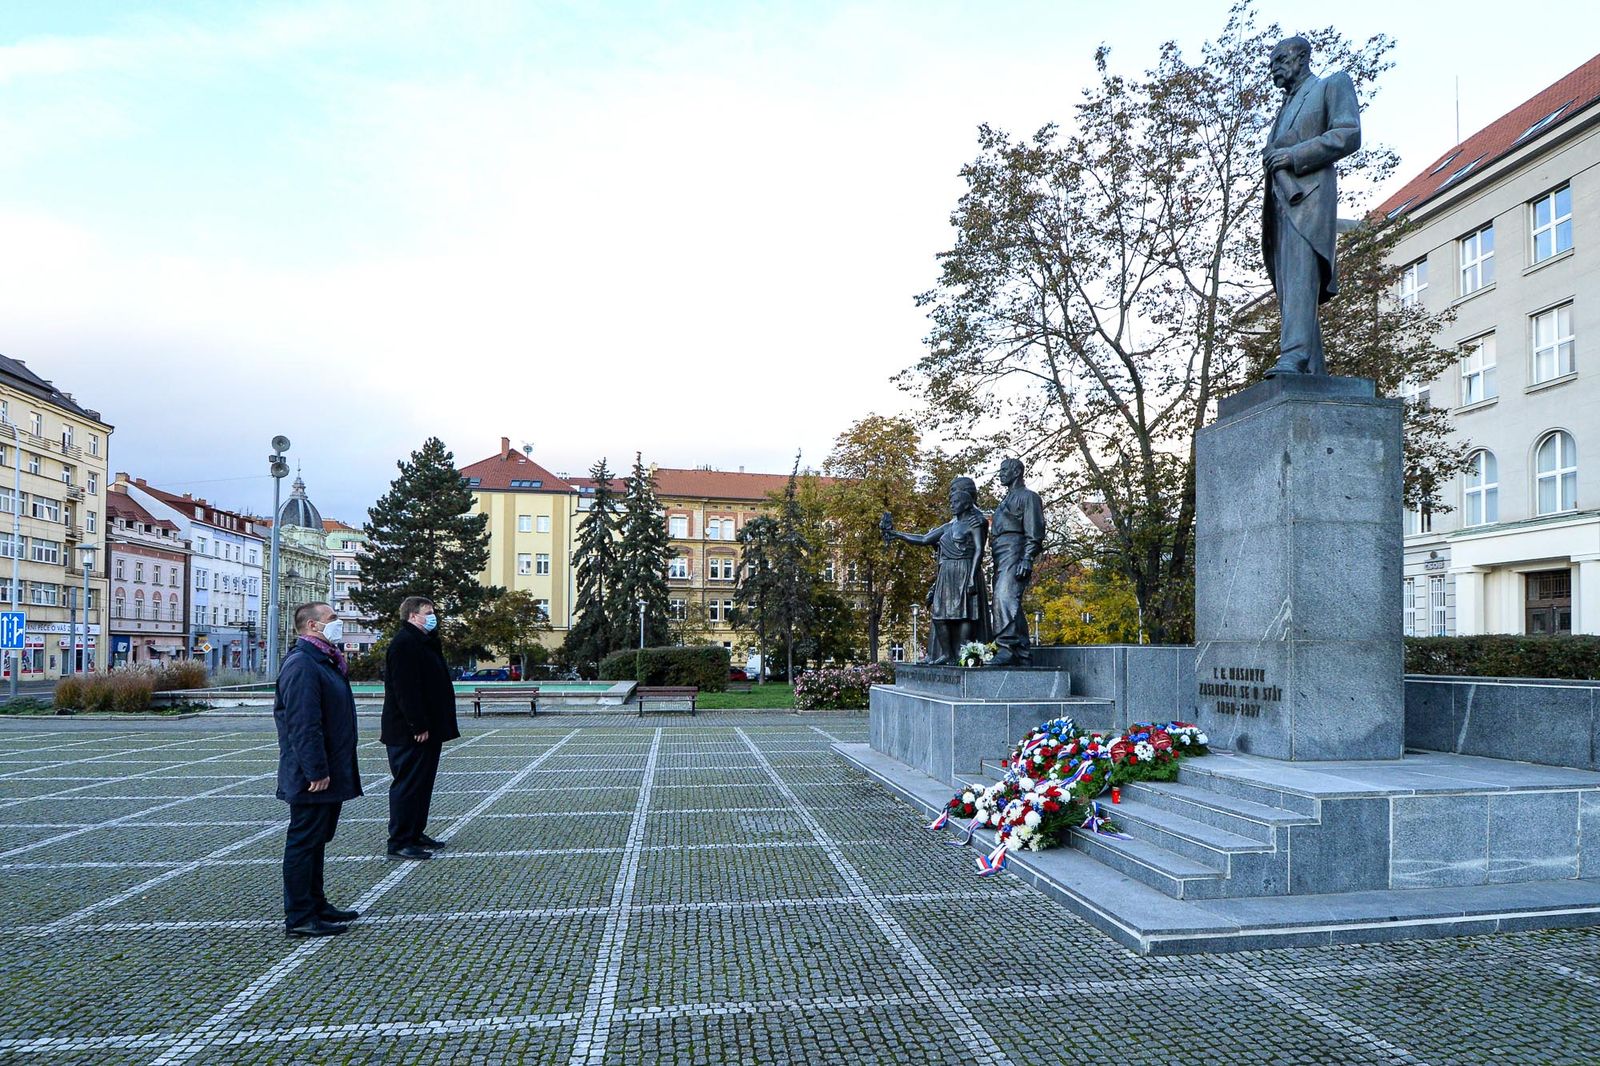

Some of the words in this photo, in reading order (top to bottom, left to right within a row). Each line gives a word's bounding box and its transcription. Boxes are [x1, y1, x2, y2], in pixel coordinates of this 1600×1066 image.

[1229, 668, 1265, 682] MASARYK
[1240, 686, 1250, 699] SE
[1263, 685, 1283, 702] STÁT
